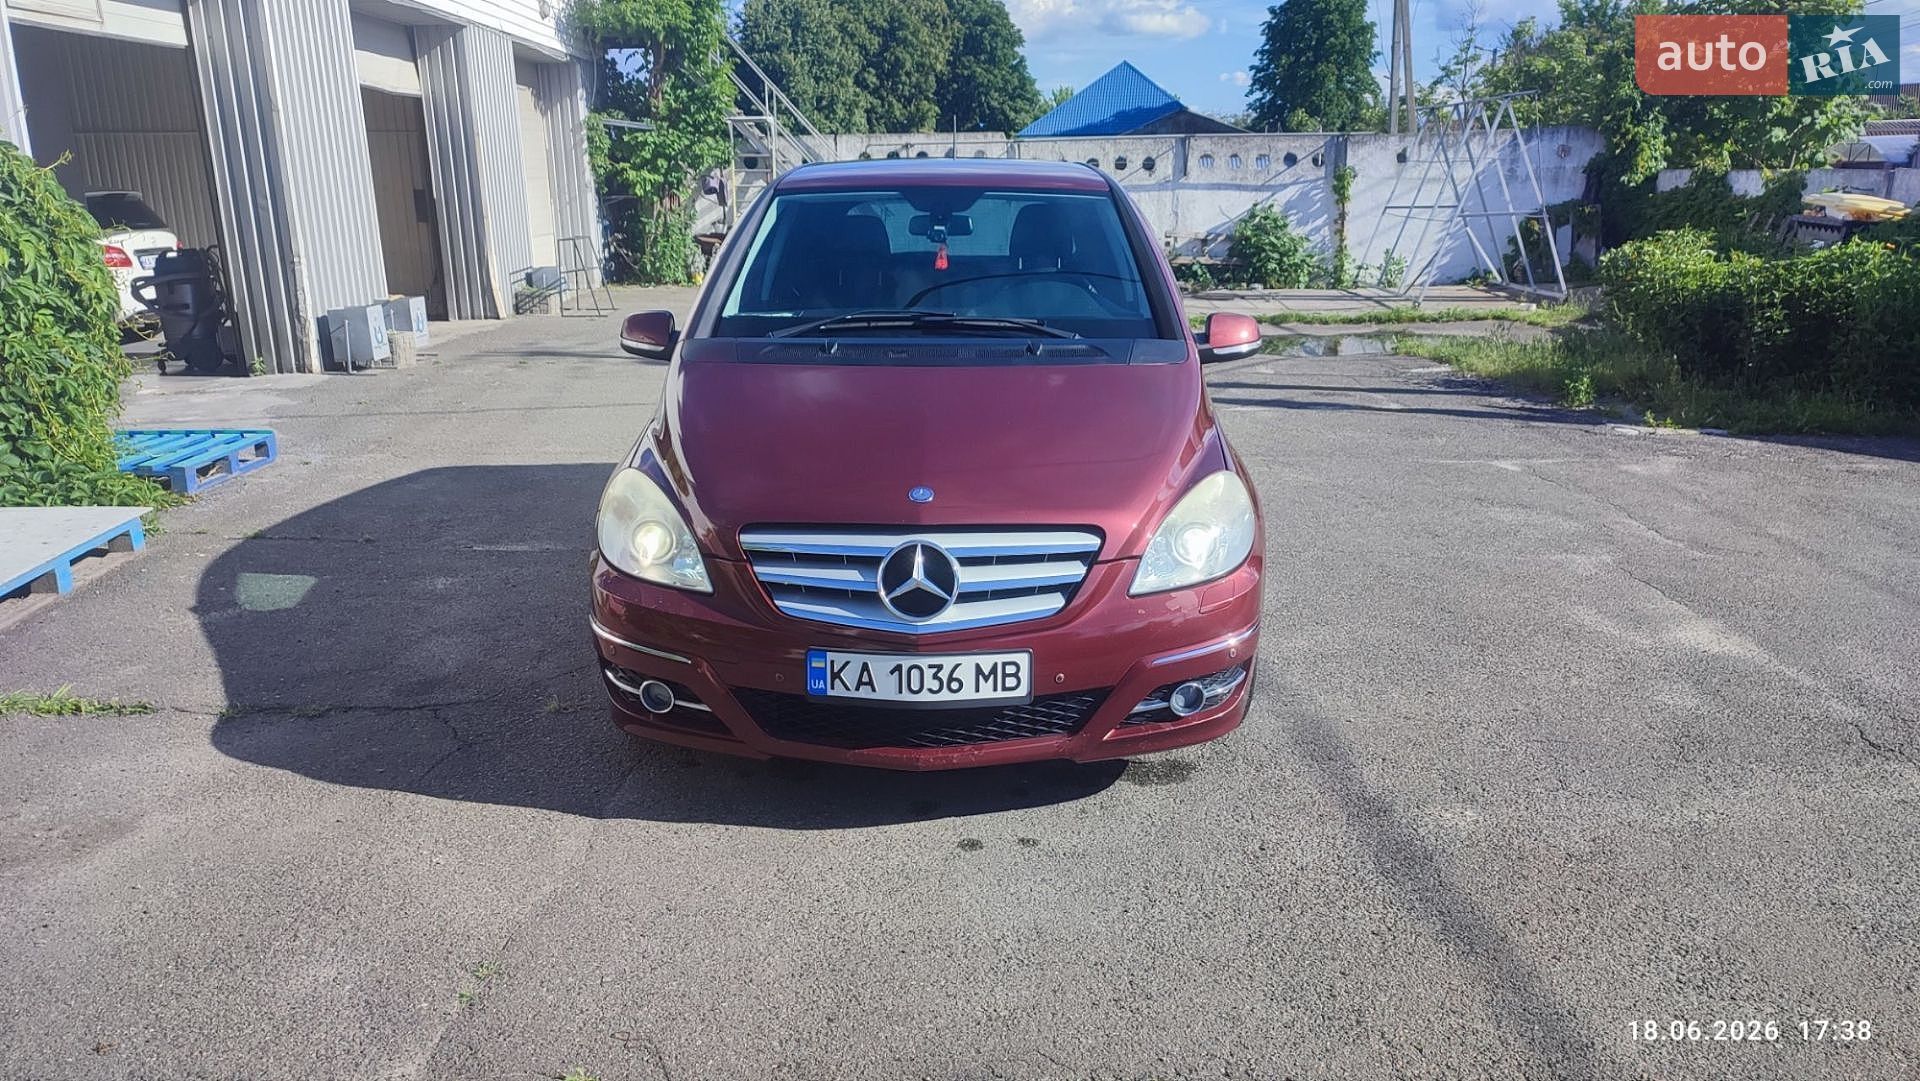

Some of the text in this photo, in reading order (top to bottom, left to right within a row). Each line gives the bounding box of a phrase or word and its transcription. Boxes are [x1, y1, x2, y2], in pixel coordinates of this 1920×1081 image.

[811, 680, 825, 690] UA
[829, 659, 1022, 695] KA 1036 MB
